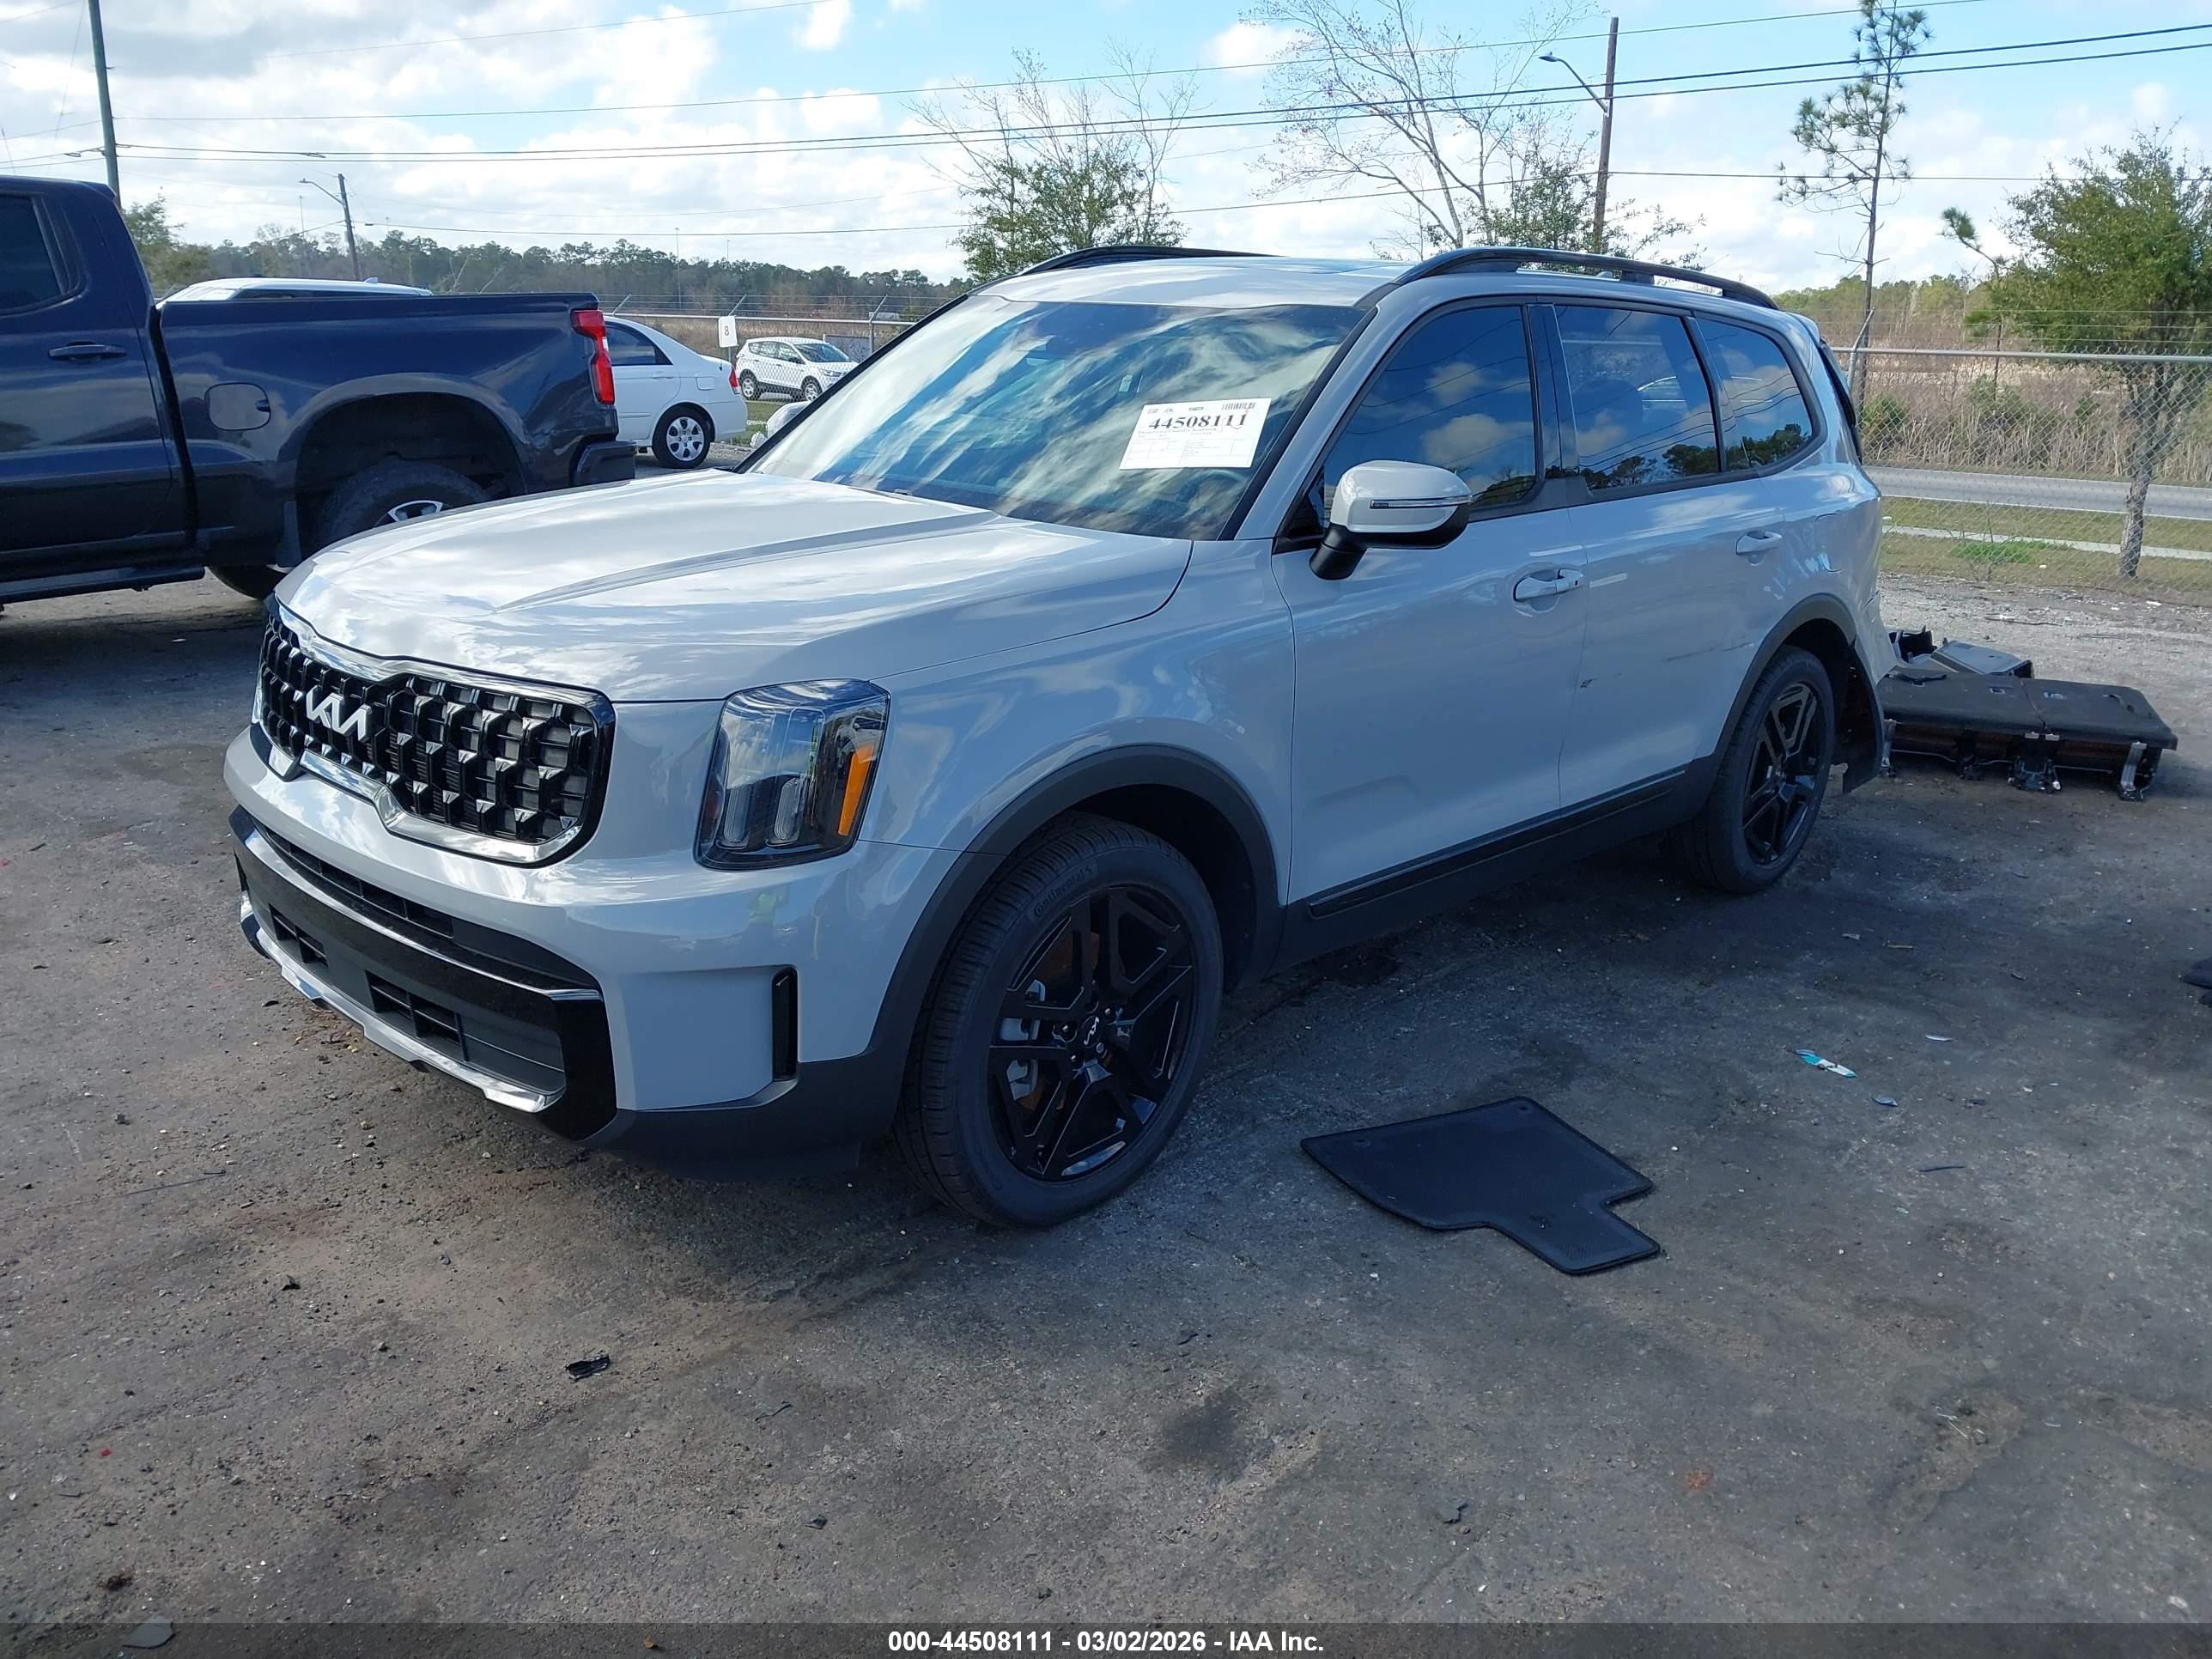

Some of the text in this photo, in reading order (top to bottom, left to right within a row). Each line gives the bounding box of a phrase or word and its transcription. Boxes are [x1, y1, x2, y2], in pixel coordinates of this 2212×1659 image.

[724, 325, 730, 336] 8
[1149, 413, 1247, 429] 44508111
[306, 684, 369, 741] KIA
